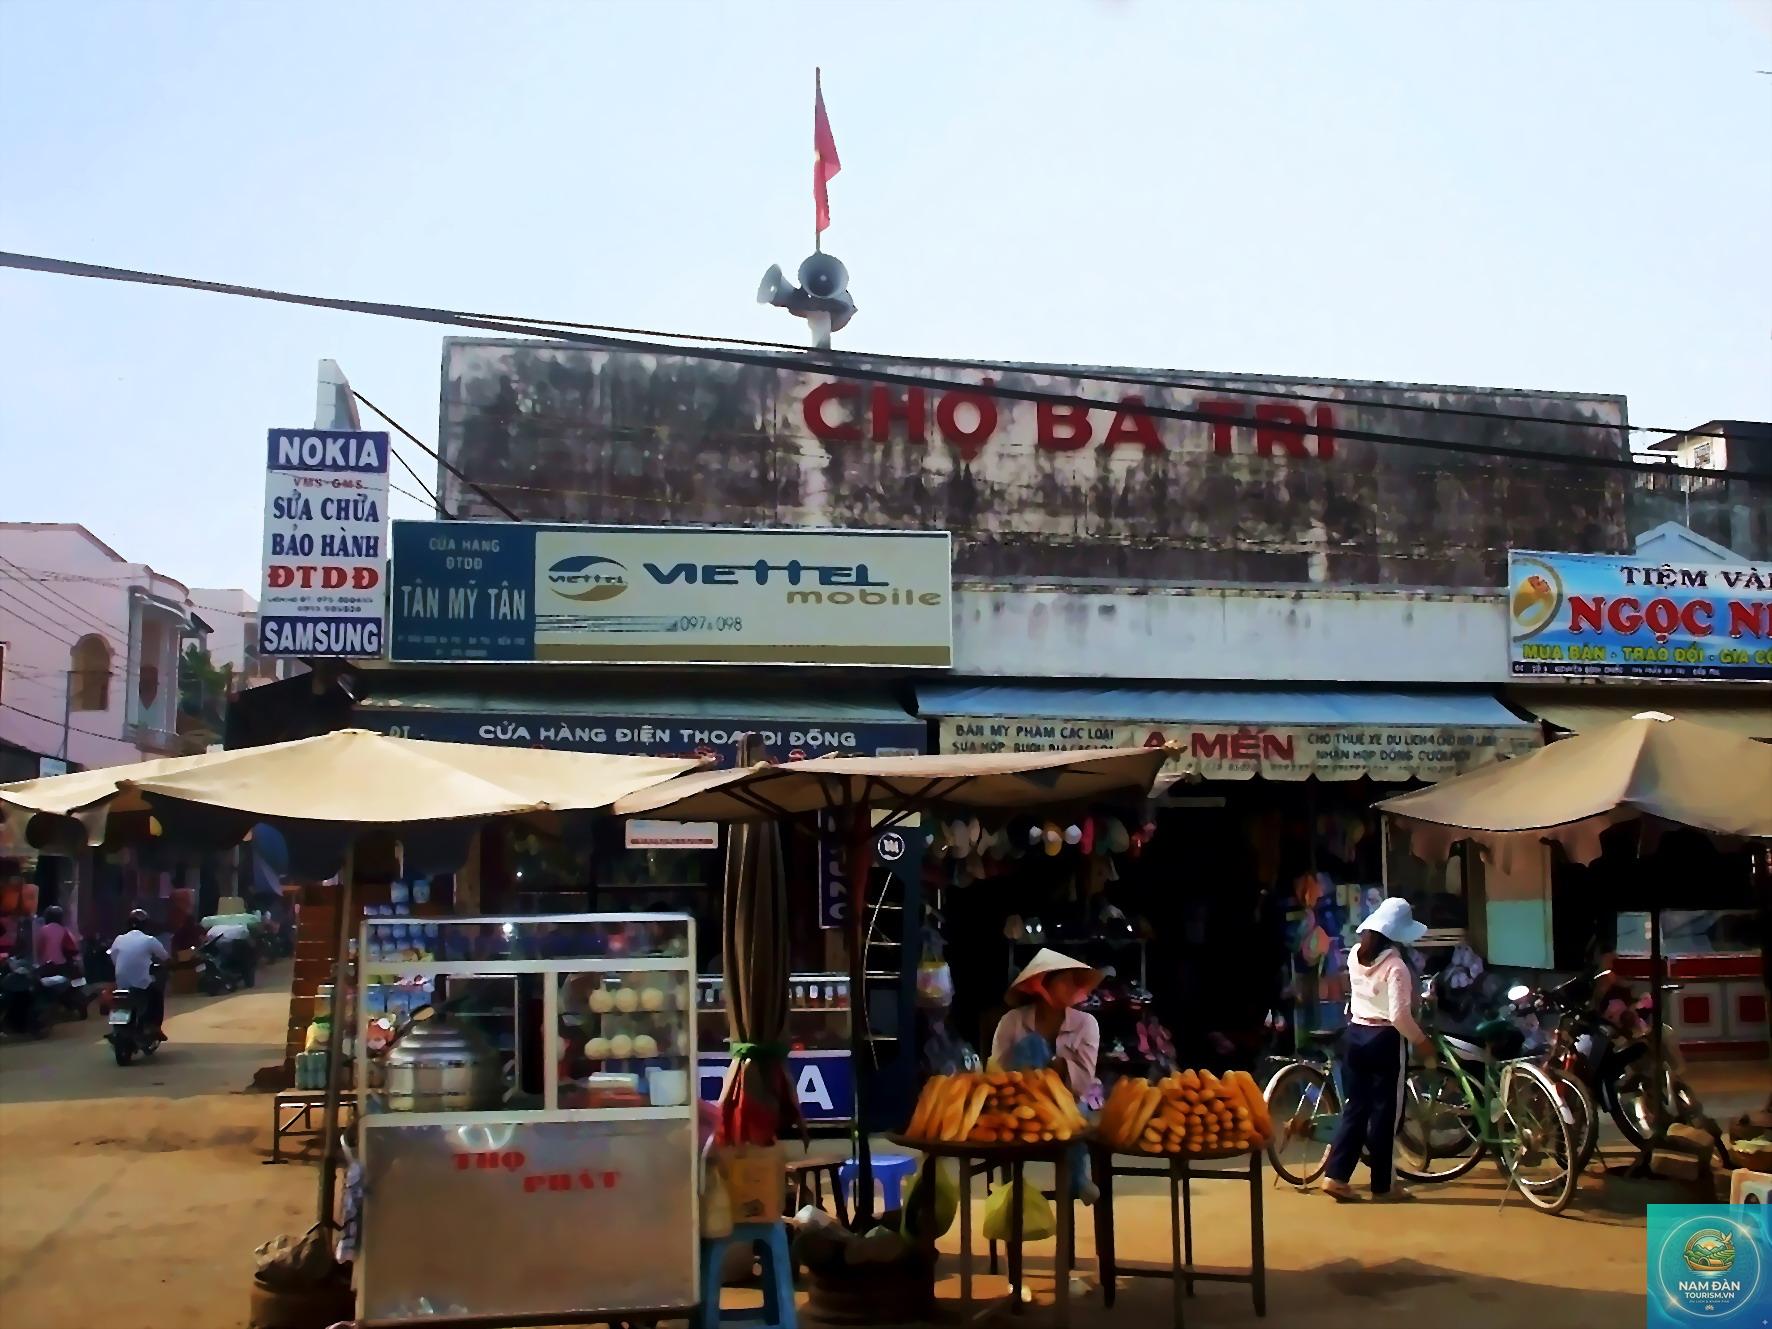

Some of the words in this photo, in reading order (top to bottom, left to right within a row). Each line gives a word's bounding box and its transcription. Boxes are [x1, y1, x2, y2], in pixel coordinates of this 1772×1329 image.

[803, 377, 998, 461] CHỢ
[1036, 394, 1165, 455] BA
[1196, 400, 1335, 459] TRI
[279, 436, 379, 467] NOKIA
[272, 523, 314, 556] BẢO
[321, 526, 379, 557] HÀNH
[268, 565, 379, 589] ĐTDĐ
[1619, 563, 1707, 589] TIỆM
[1721, 567, 1772, 591] VÀ
[401, 578, 439, 618] TÂN
[448, 579, 478, 619] MỸ
[487, 580, 526, 620] TÂN
[786, 588, 942, 606] mobile
[679, 615, 706, 631] 097
[716, 615, 743, 632] 098
[1567, 595, 1714, 644] NGỌC
[264, 621, 379, 652] SAMSUNG
[1523, 643, 1563, 659] MUA
[1623, 647, 1669, 662] TRAO
[478, 720, 531, 740] CỬA
[540, 722, 607, 742] HÀNG
[615, 725, 671, 746] ĐIỆN
[788, 728, 857, 750] ĐỘNG
